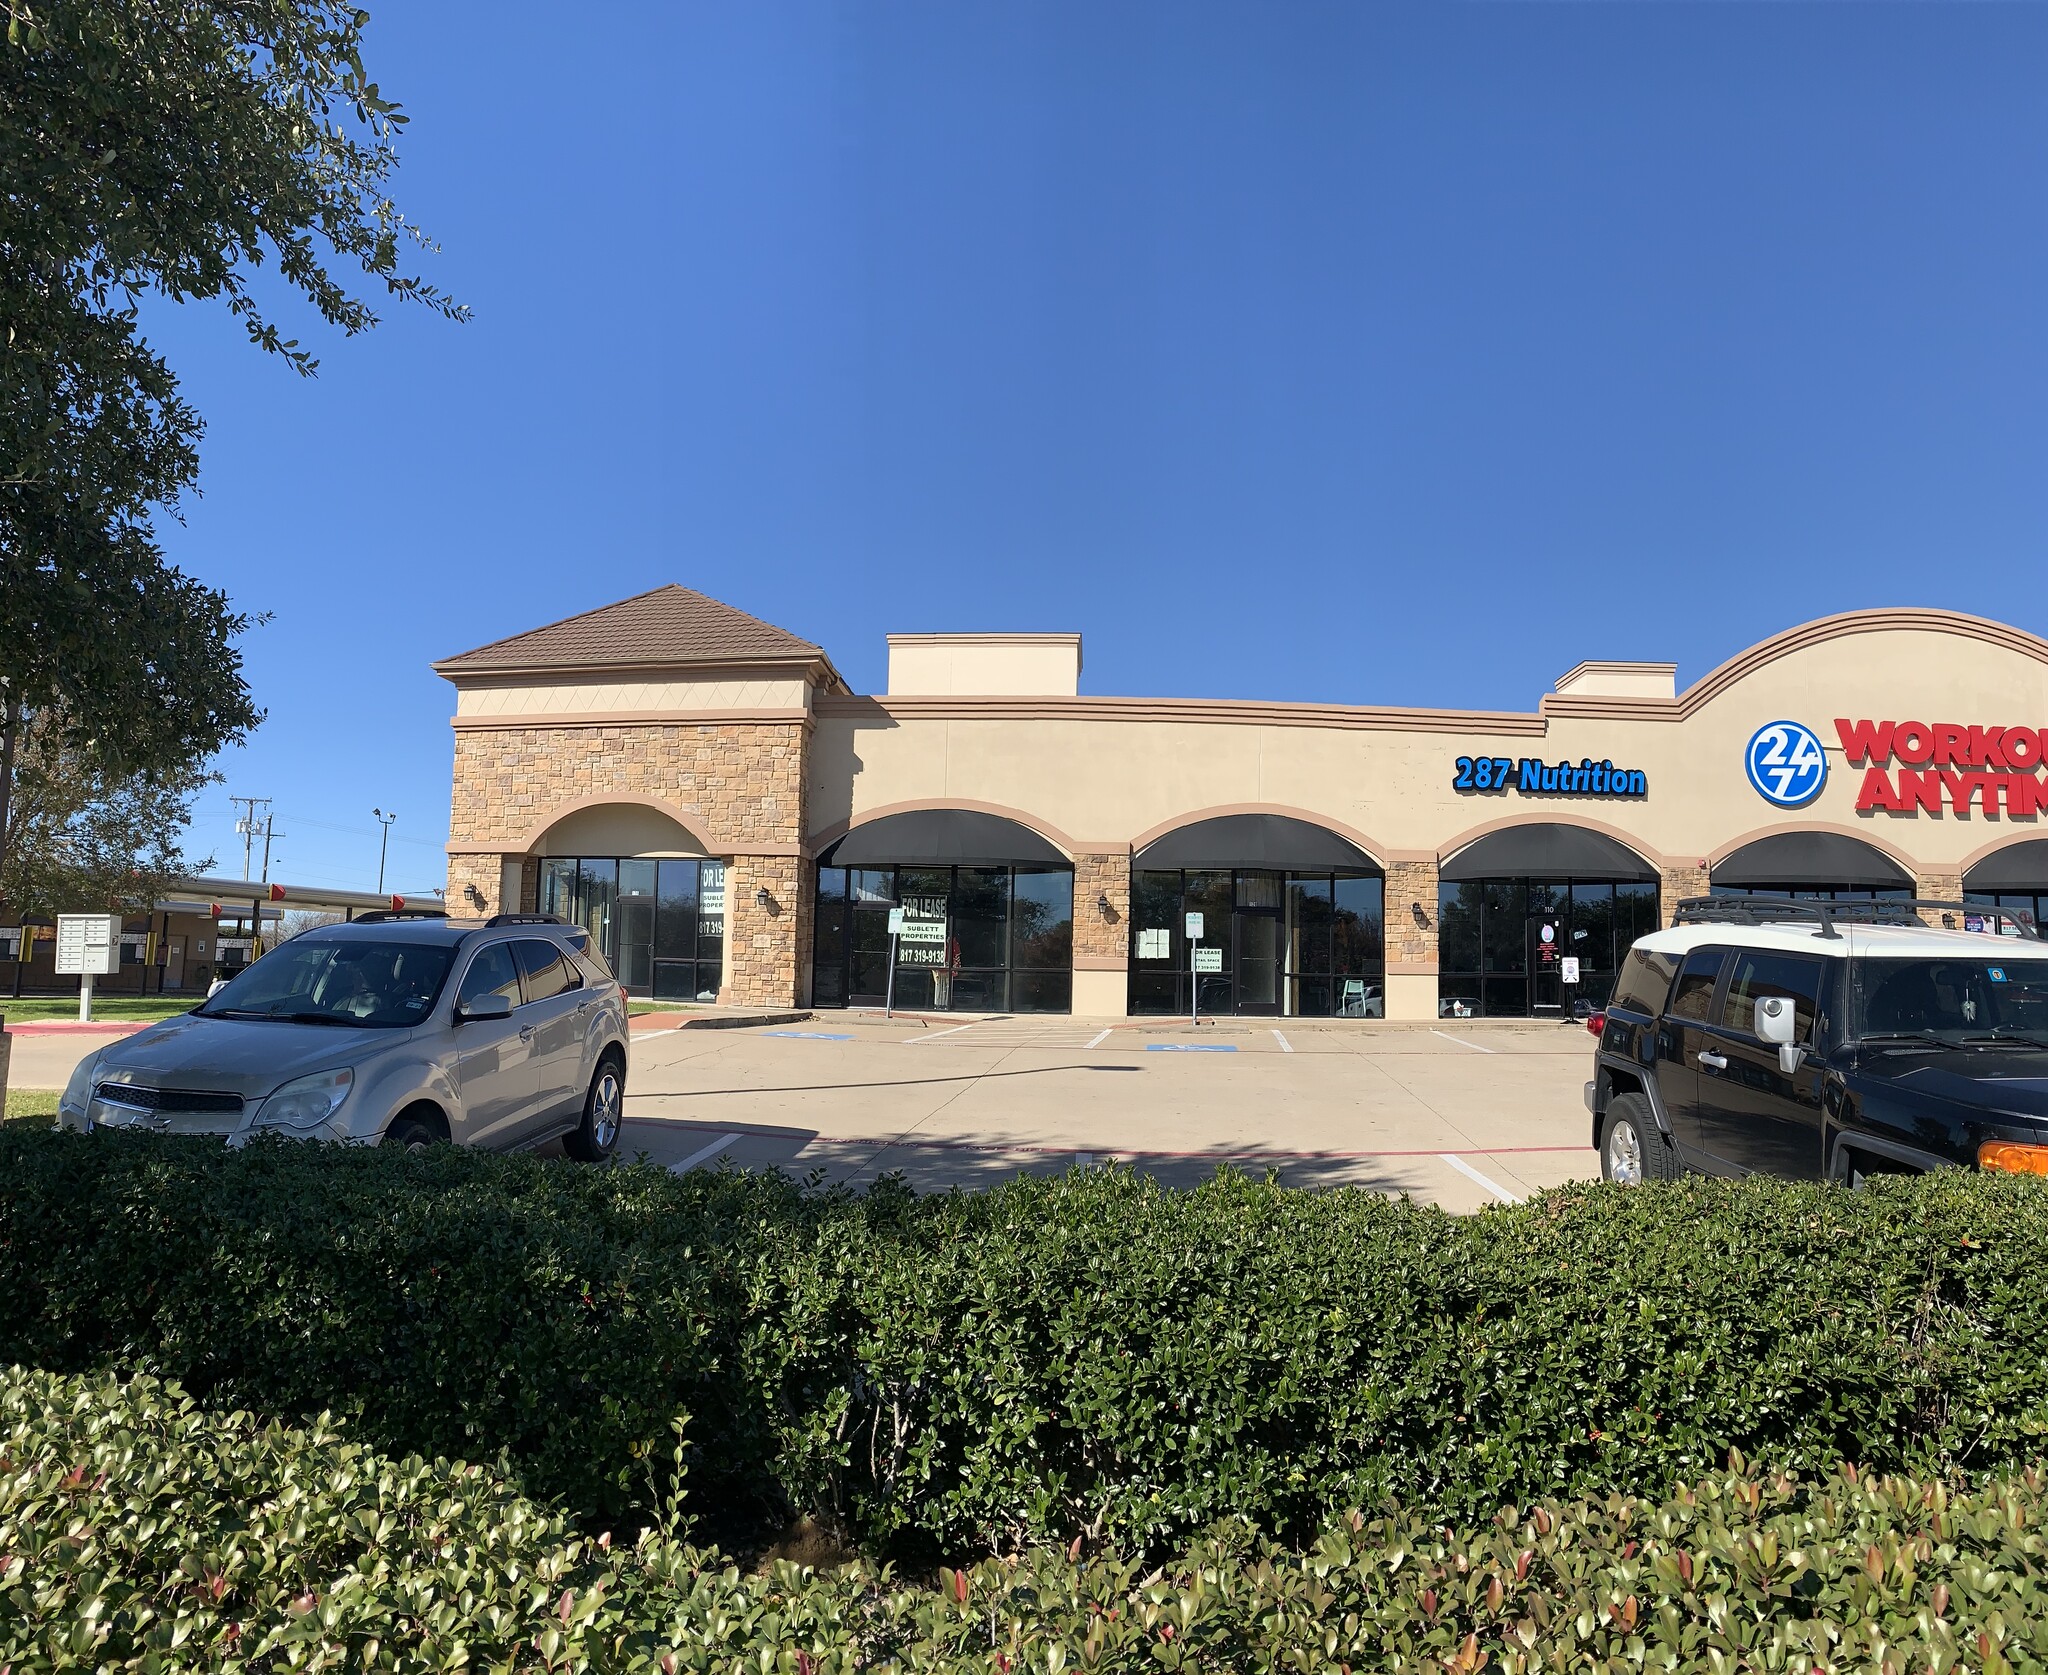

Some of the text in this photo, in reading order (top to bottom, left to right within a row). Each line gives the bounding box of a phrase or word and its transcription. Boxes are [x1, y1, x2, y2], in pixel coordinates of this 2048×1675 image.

[1758, 727, 1822, 777] 24
[1833, 718, 2048, 768] WORKO
[1455, 757, 1646, 794] 287 Nutrition
[1767, 767, 1796, 798] 7
[902, 898, 946, 918] FOR LEASE
[1544, 906, 1554, 914] 110
[698, 921, 710, 934] 817
[900, 949, 945, 963] 817 319-9138
